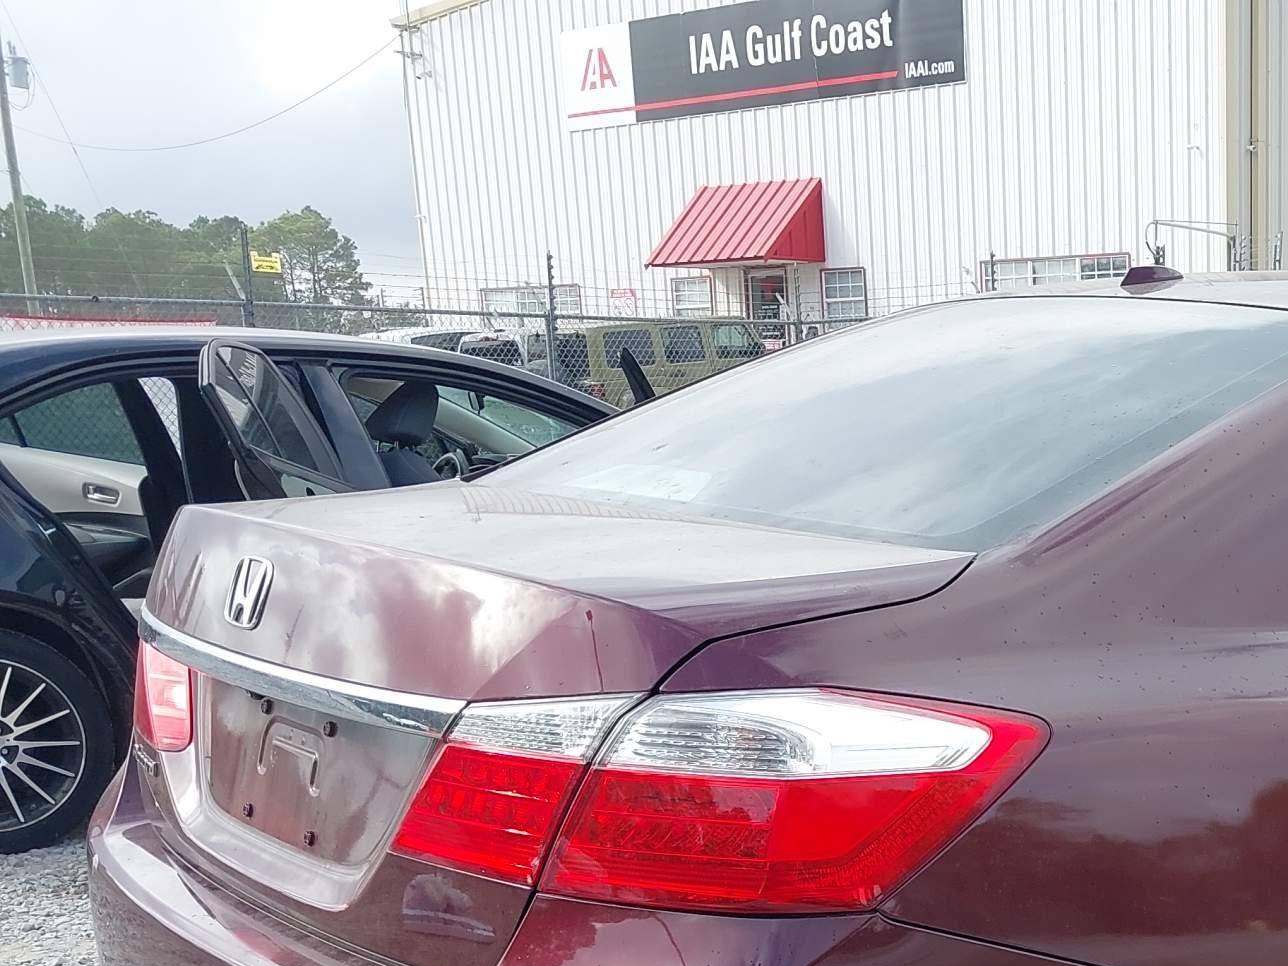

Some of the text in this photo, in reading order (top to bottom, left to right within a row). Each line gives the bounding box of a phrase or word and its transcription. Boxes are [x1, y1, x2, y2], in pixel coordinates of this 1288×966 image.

[688, 9, 894, 75] IAA Gulf Coast
